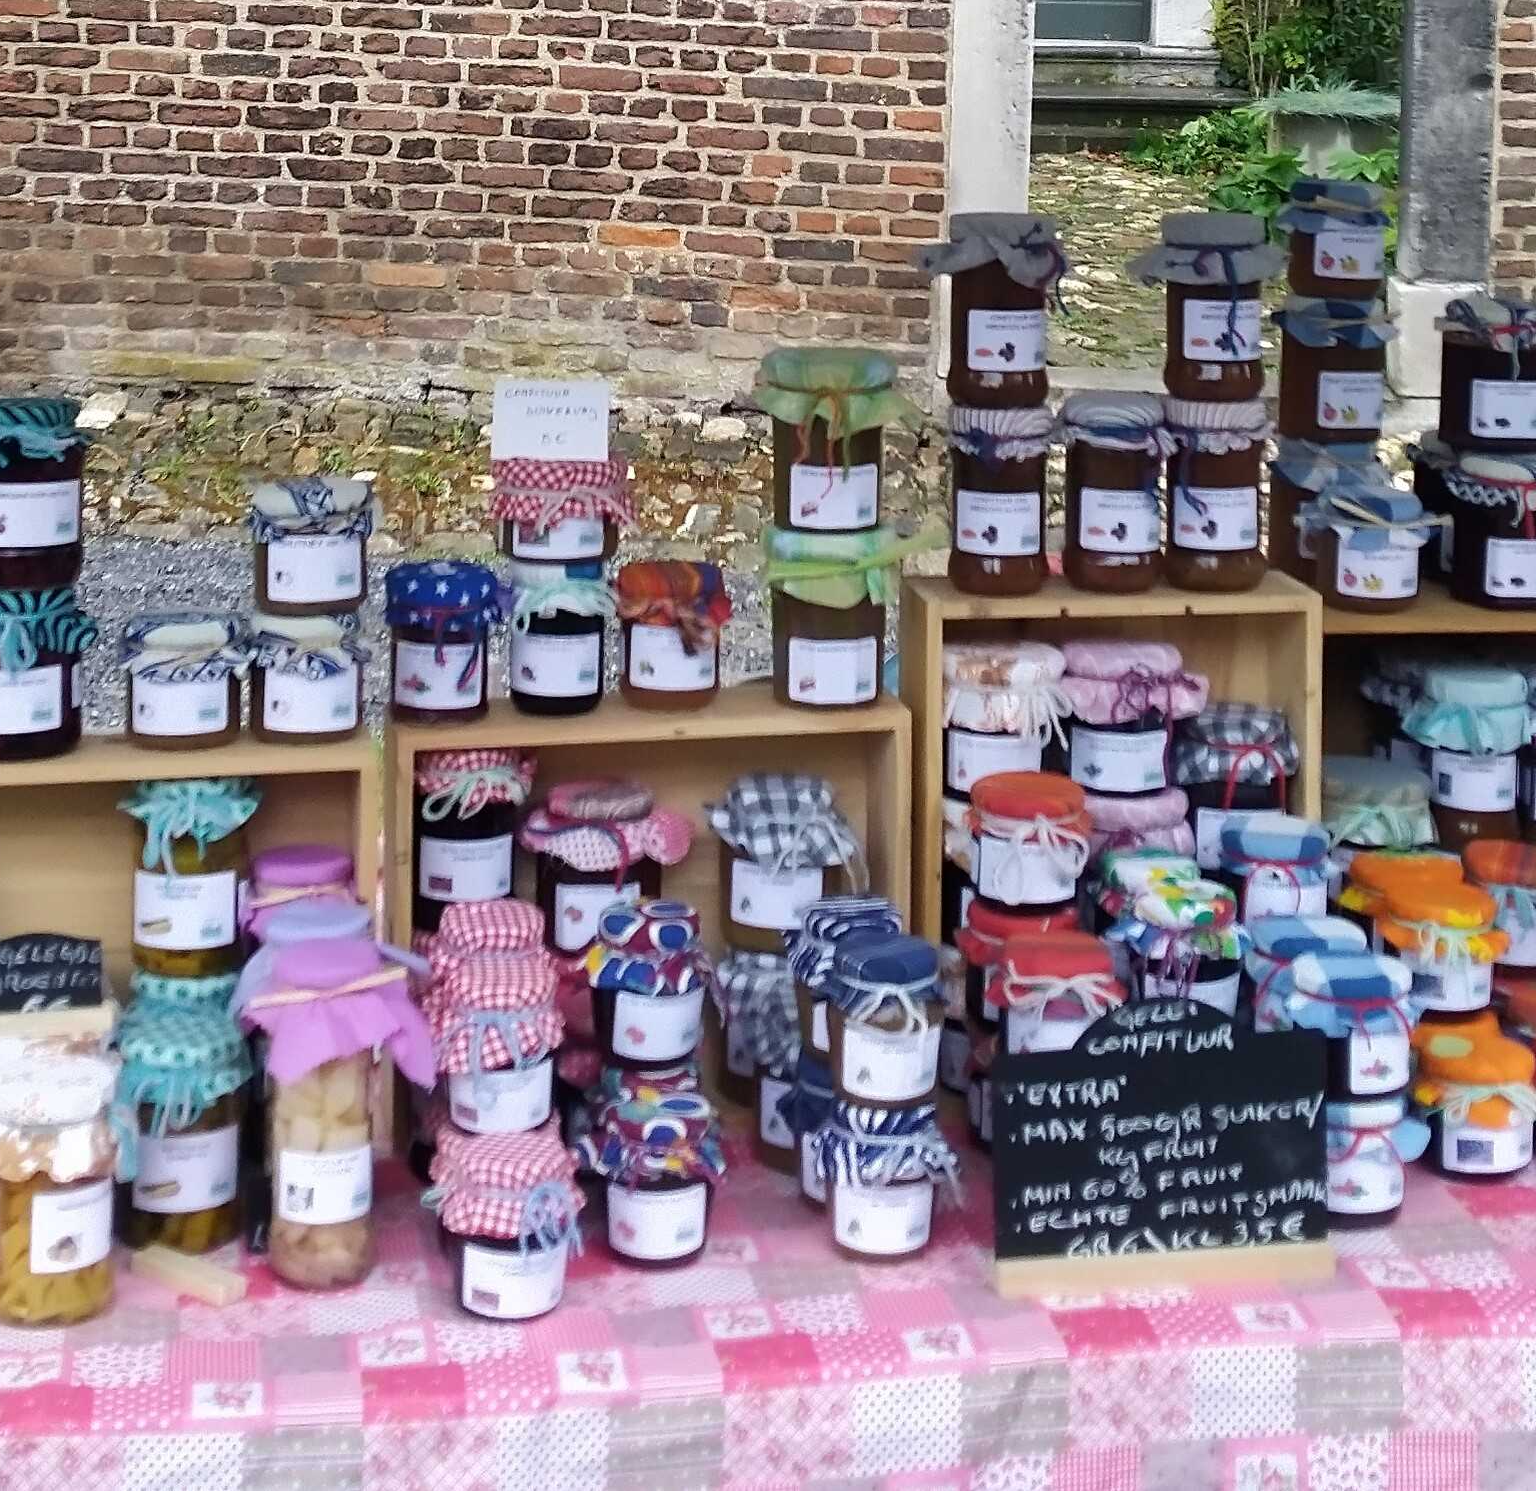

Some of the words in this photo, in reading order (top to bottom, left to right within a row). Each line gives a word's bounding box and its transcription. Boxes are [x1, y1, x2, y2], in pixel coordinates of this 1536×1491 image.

[1087, 1023, 1235, 1058] CONFITUUR
[1023, 1117, 1088, 1146] MAX
[1144, 1136, 1219, 1165] FRUIT
[1023, 1182, 1071, 1209] MIN
[1158, 1163, 1244, 1193] FRUIT
[1029, 1204, 1133, 1234] ECHTE
